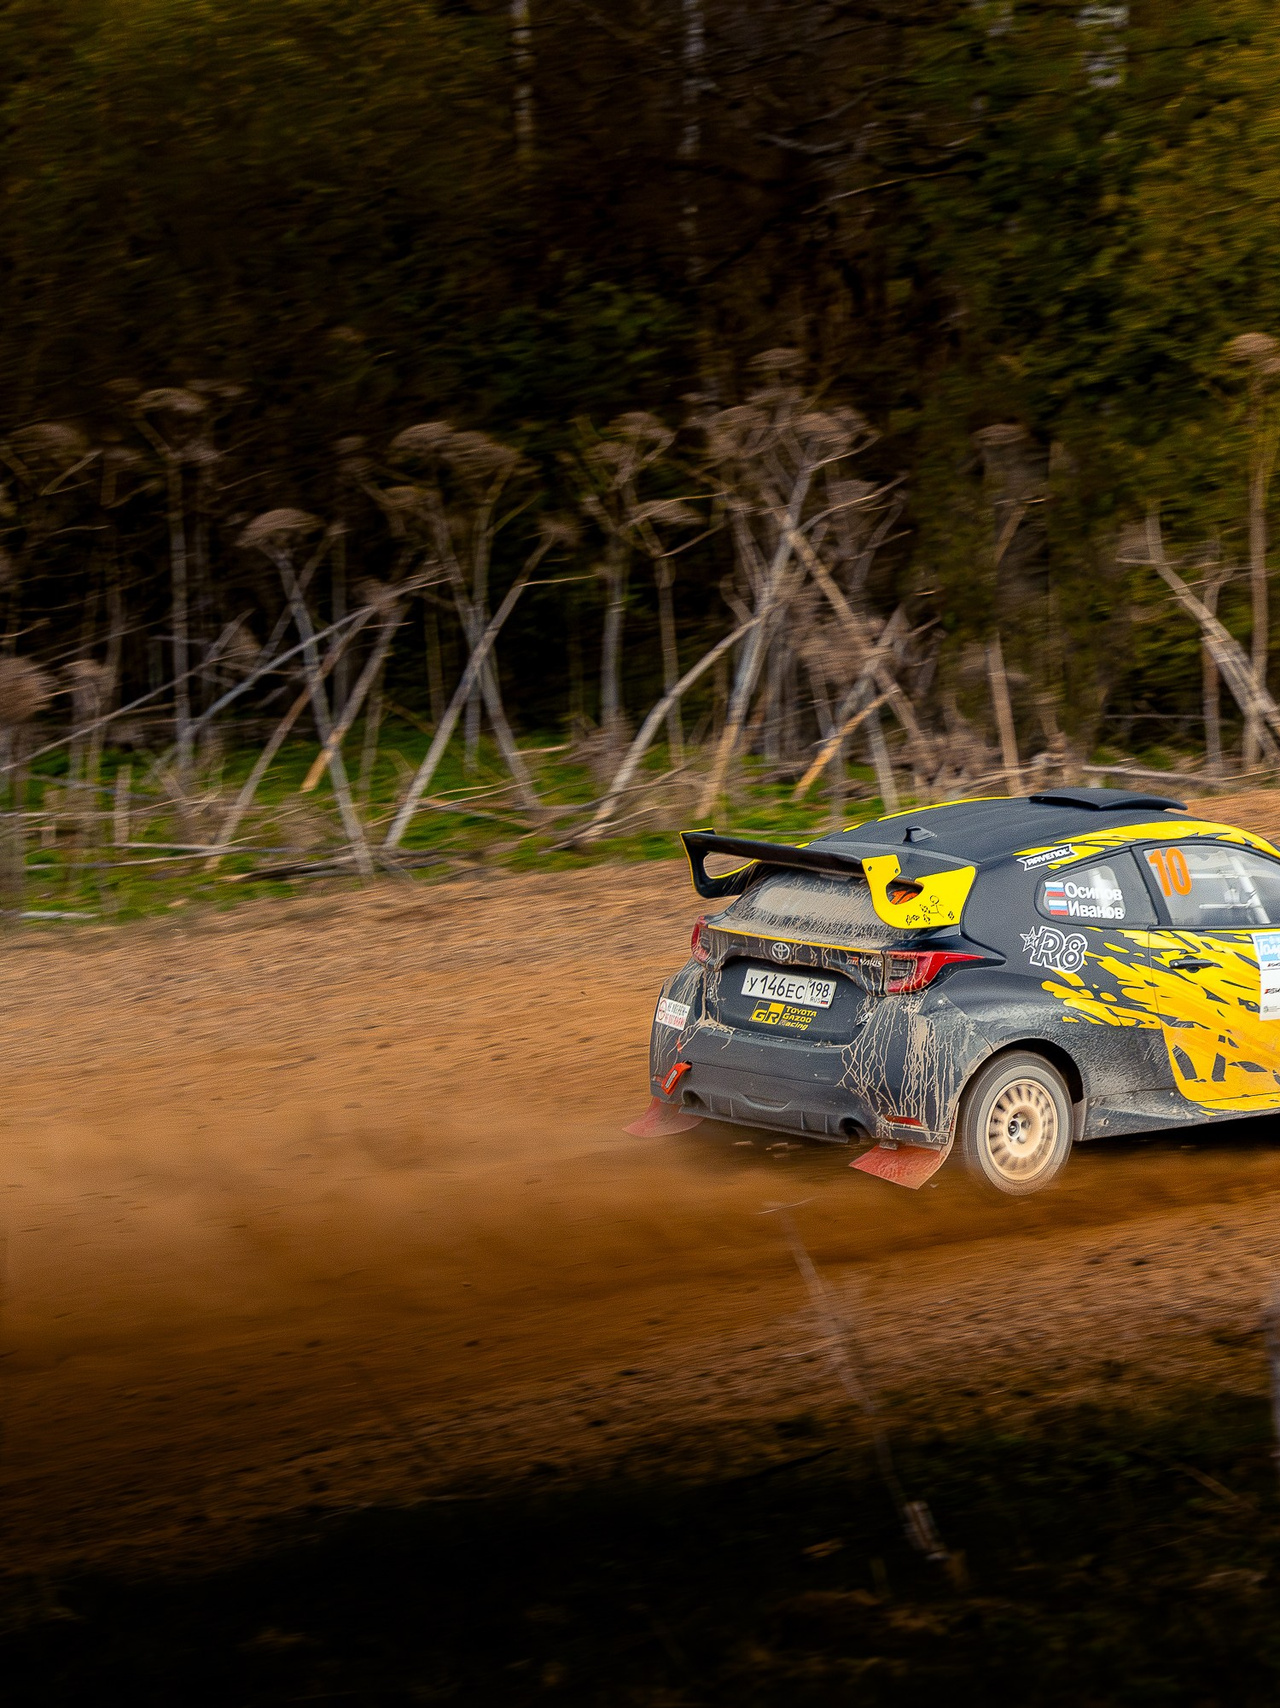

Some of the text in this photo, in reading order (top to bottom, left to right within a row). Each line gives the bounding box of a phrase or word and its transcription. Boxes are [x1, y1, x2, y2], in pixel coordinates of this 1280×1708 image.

[1026, 848, 1071, 866] RAVENOL
[1148, 847, 1192, 897] 10
[1064, 882, 1123, 900] Осипов
[1067, 900, 1125, 920] Иванов
[1029, 926, 1088, 974] R8
[809, 981, 830, 998] 198
[782, 1013, 812, 1023] GAZOO
[786, 1005, 818, 1018] TOYOTA
[779, 1019, 809, 1031] Racing
